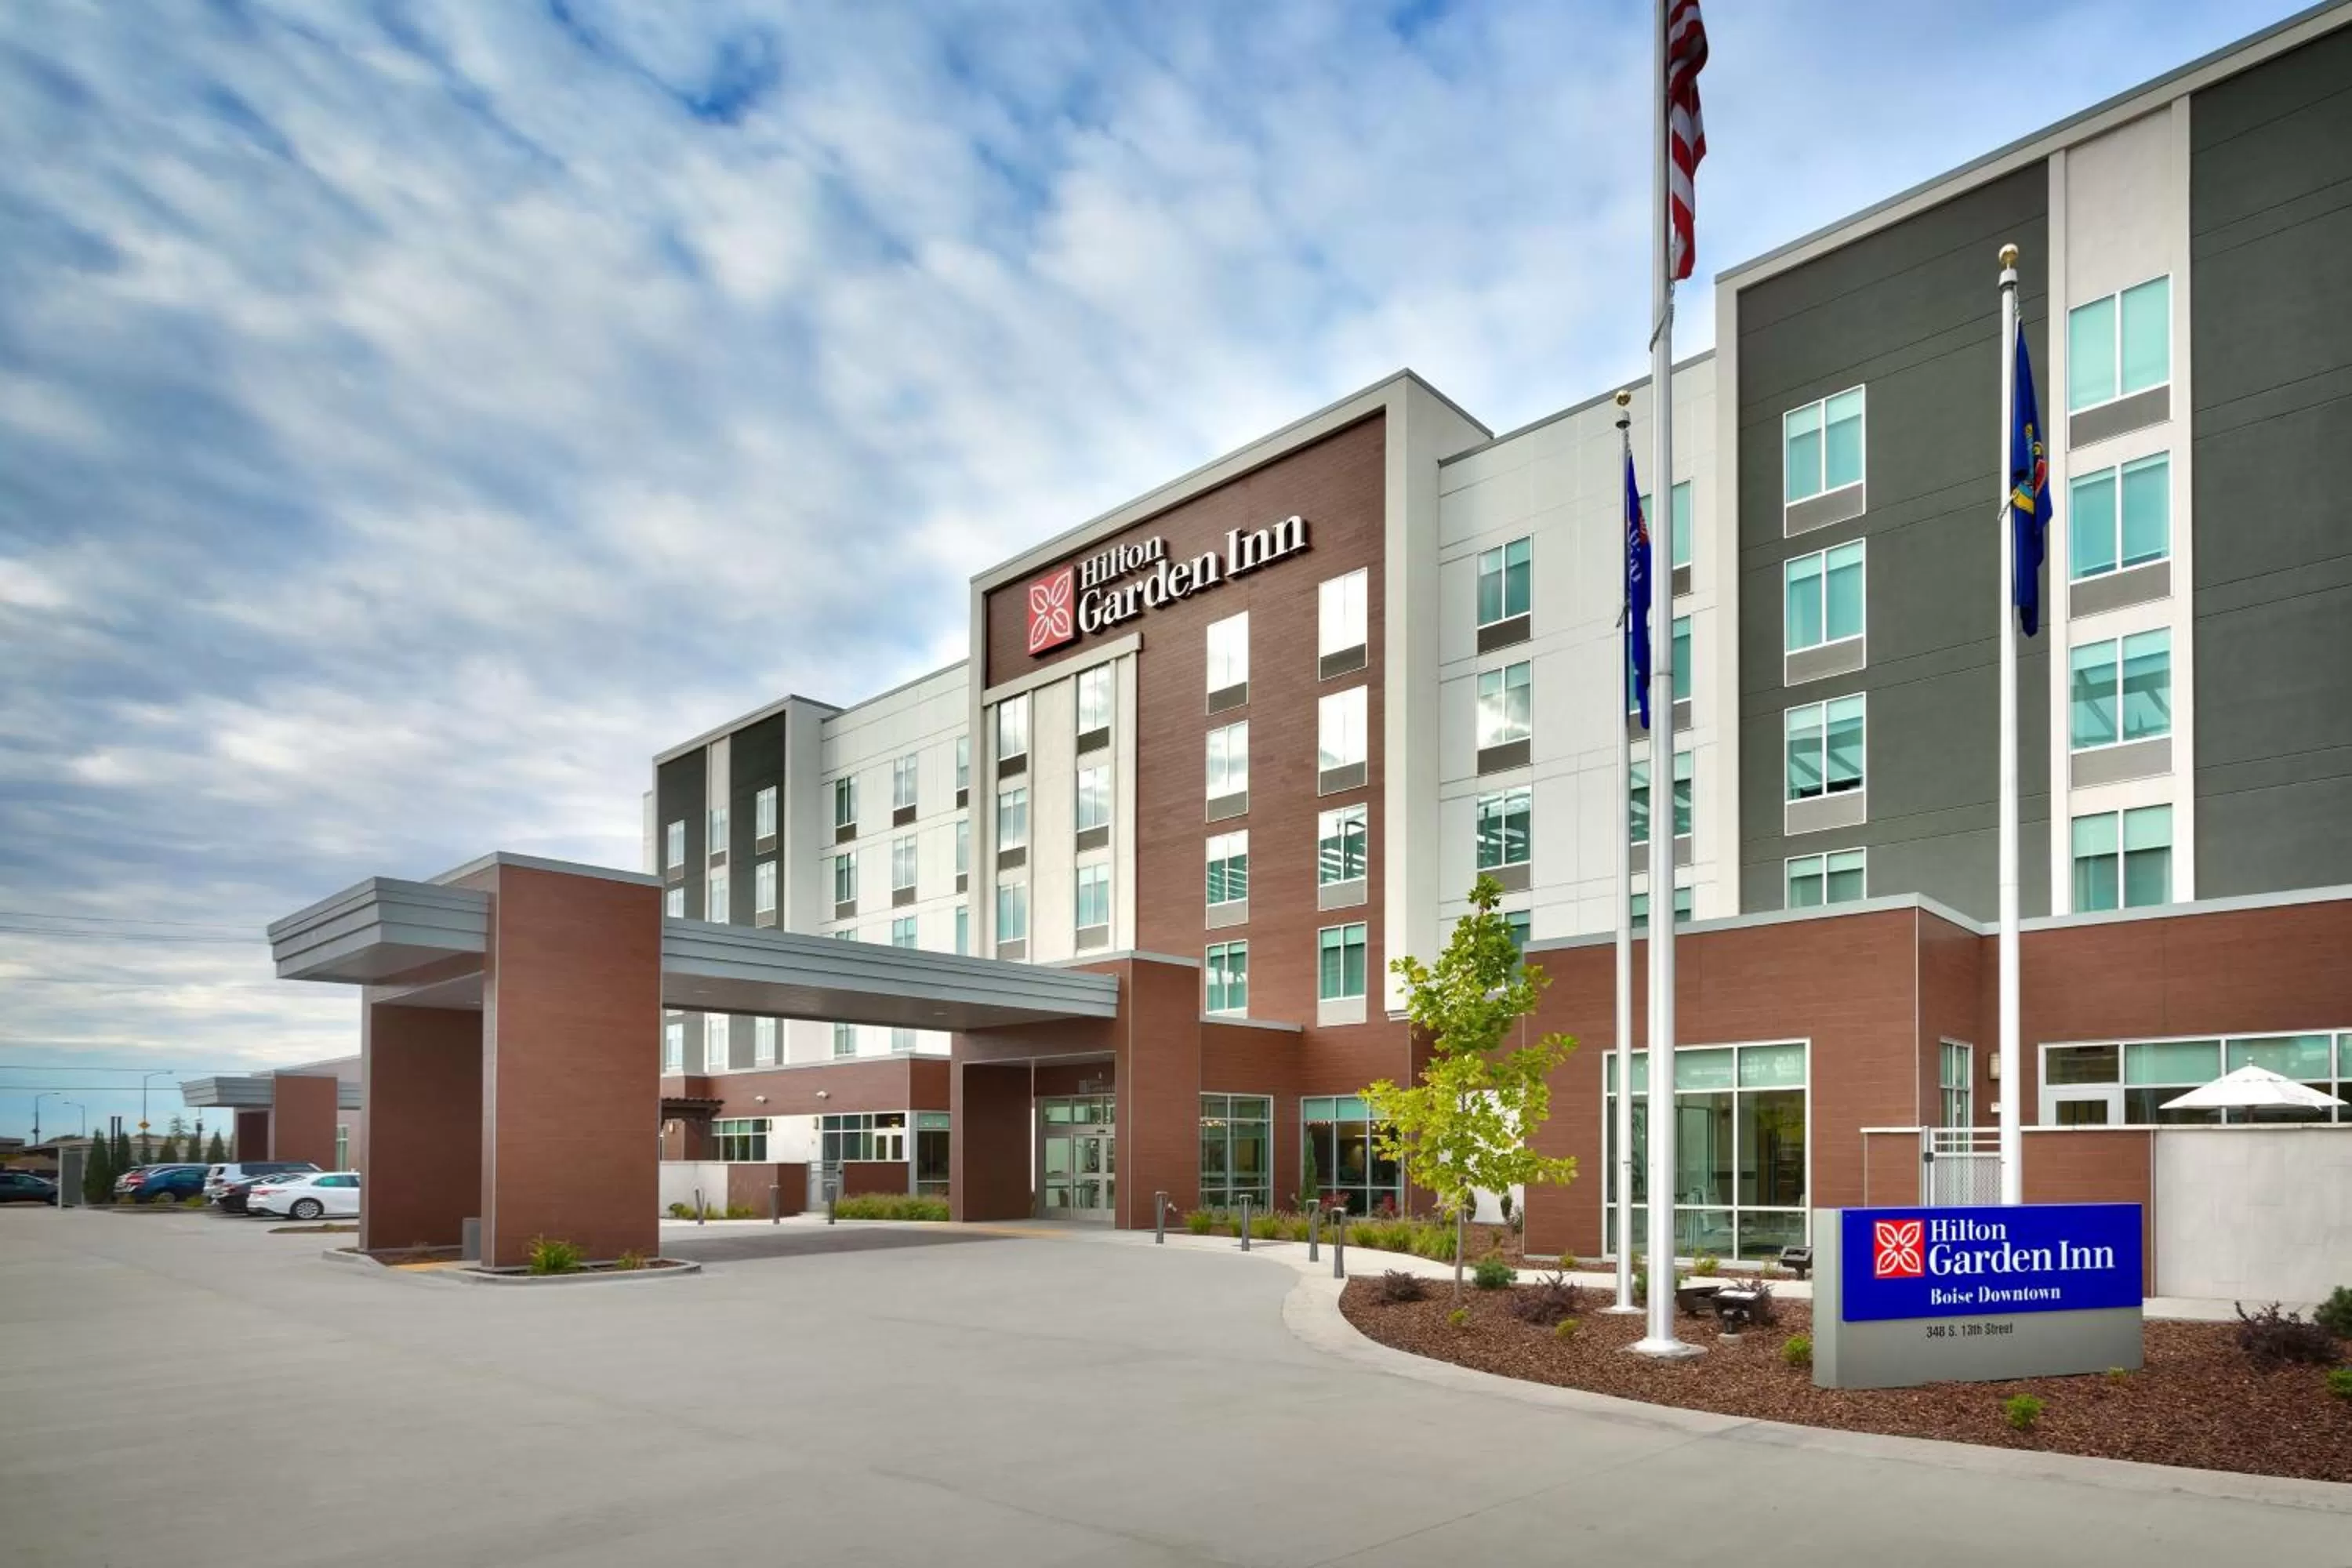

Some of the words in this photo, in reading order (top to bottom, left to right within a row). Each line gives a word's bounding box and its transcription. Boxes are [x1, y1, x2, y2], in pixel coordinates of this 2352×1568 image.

[1078, 550, 1220, 633] Garden
[1225, 514, 1308, 576] Inn
[1080, 535, 1164, 590] Hilton
[1929, 1219, 2006, 1242] Hilton
[1929, 1242, 2053, 1276] Garden
[2058, 1240, 2115, 1270] Inn
[1930, 1287, 1973, 1305] Boise
[1978, 1286, 2061, 1303] Downtown
[1926, 1326, 1945, 1338] 348
[1948, 1324, 1958, 1338] S.
[1961, 1323, 1983, 1337] 13th
[1984, 1322, 2013, 1336] Street
